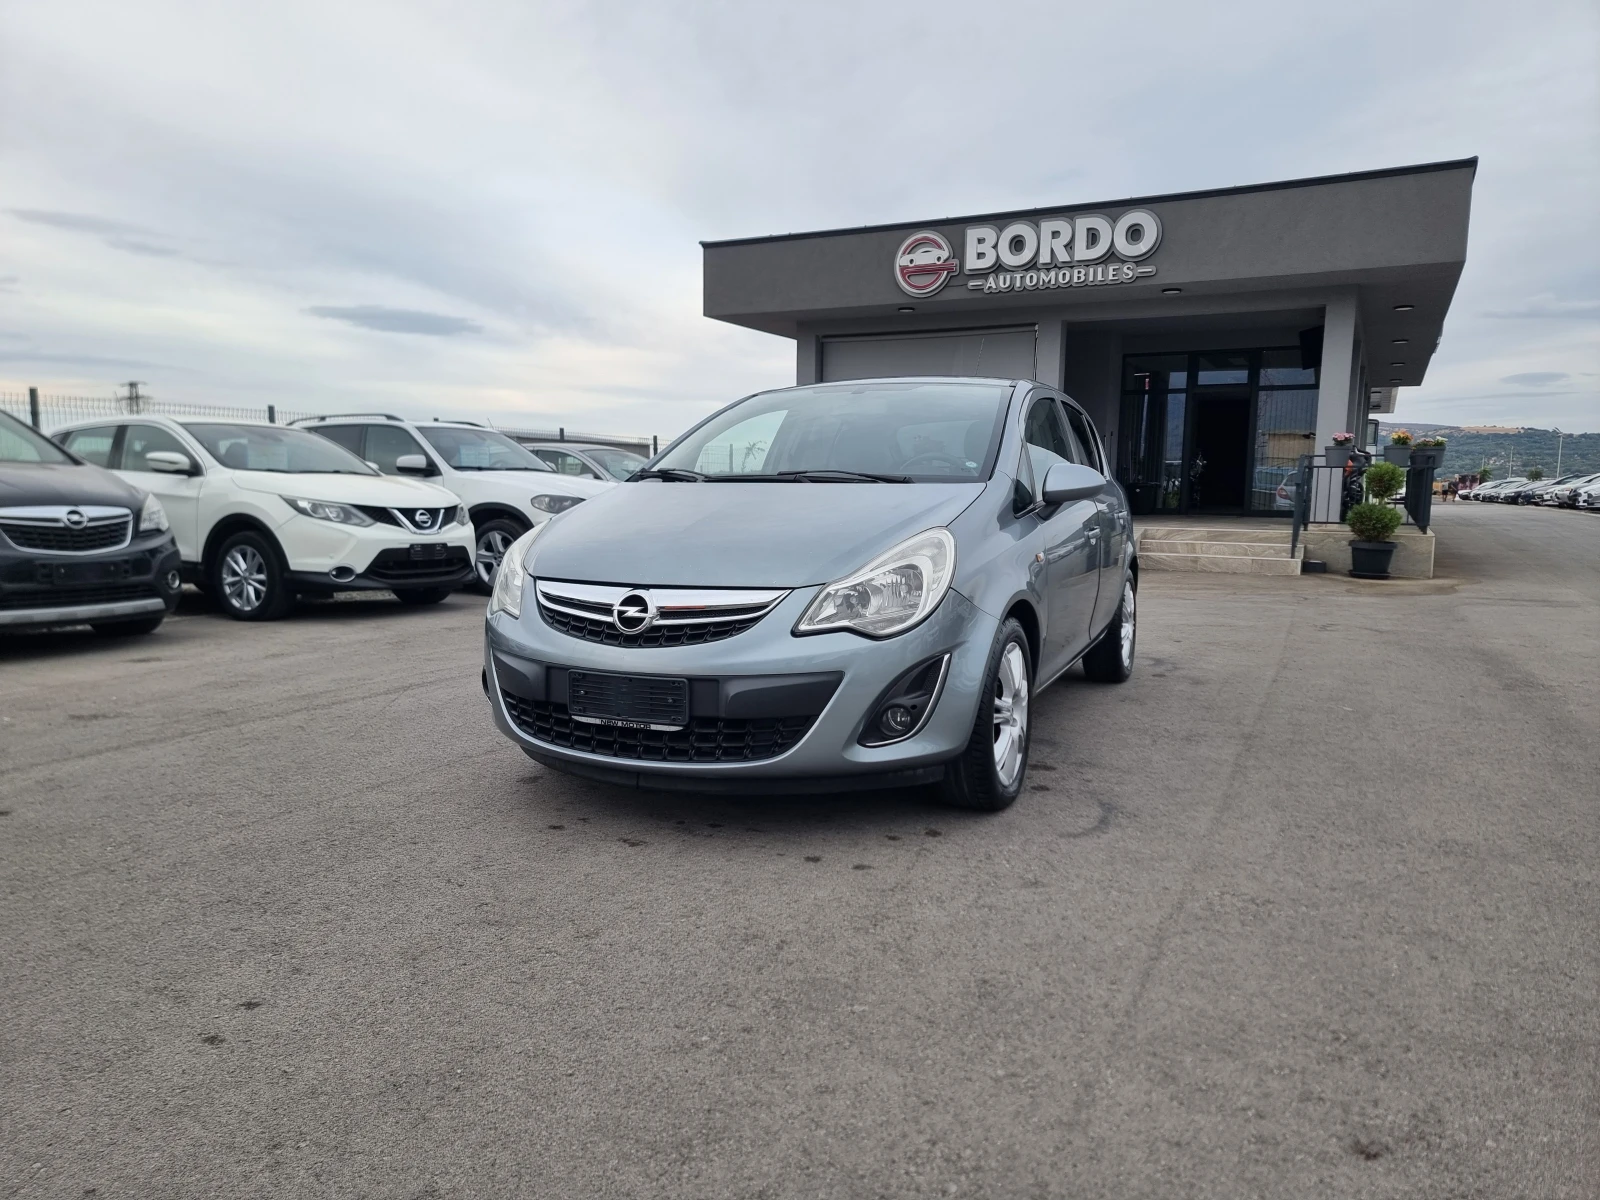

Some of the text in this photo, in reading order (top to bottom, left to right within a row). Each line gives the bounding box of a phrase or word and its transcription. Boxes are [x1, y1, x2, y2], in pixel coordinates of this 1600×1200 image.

[965, 211, 1159, 270] BORDO
[984, 264, 1135, 291] AUTOMOBILES
[621, 721, 651, 730] MOTOR
